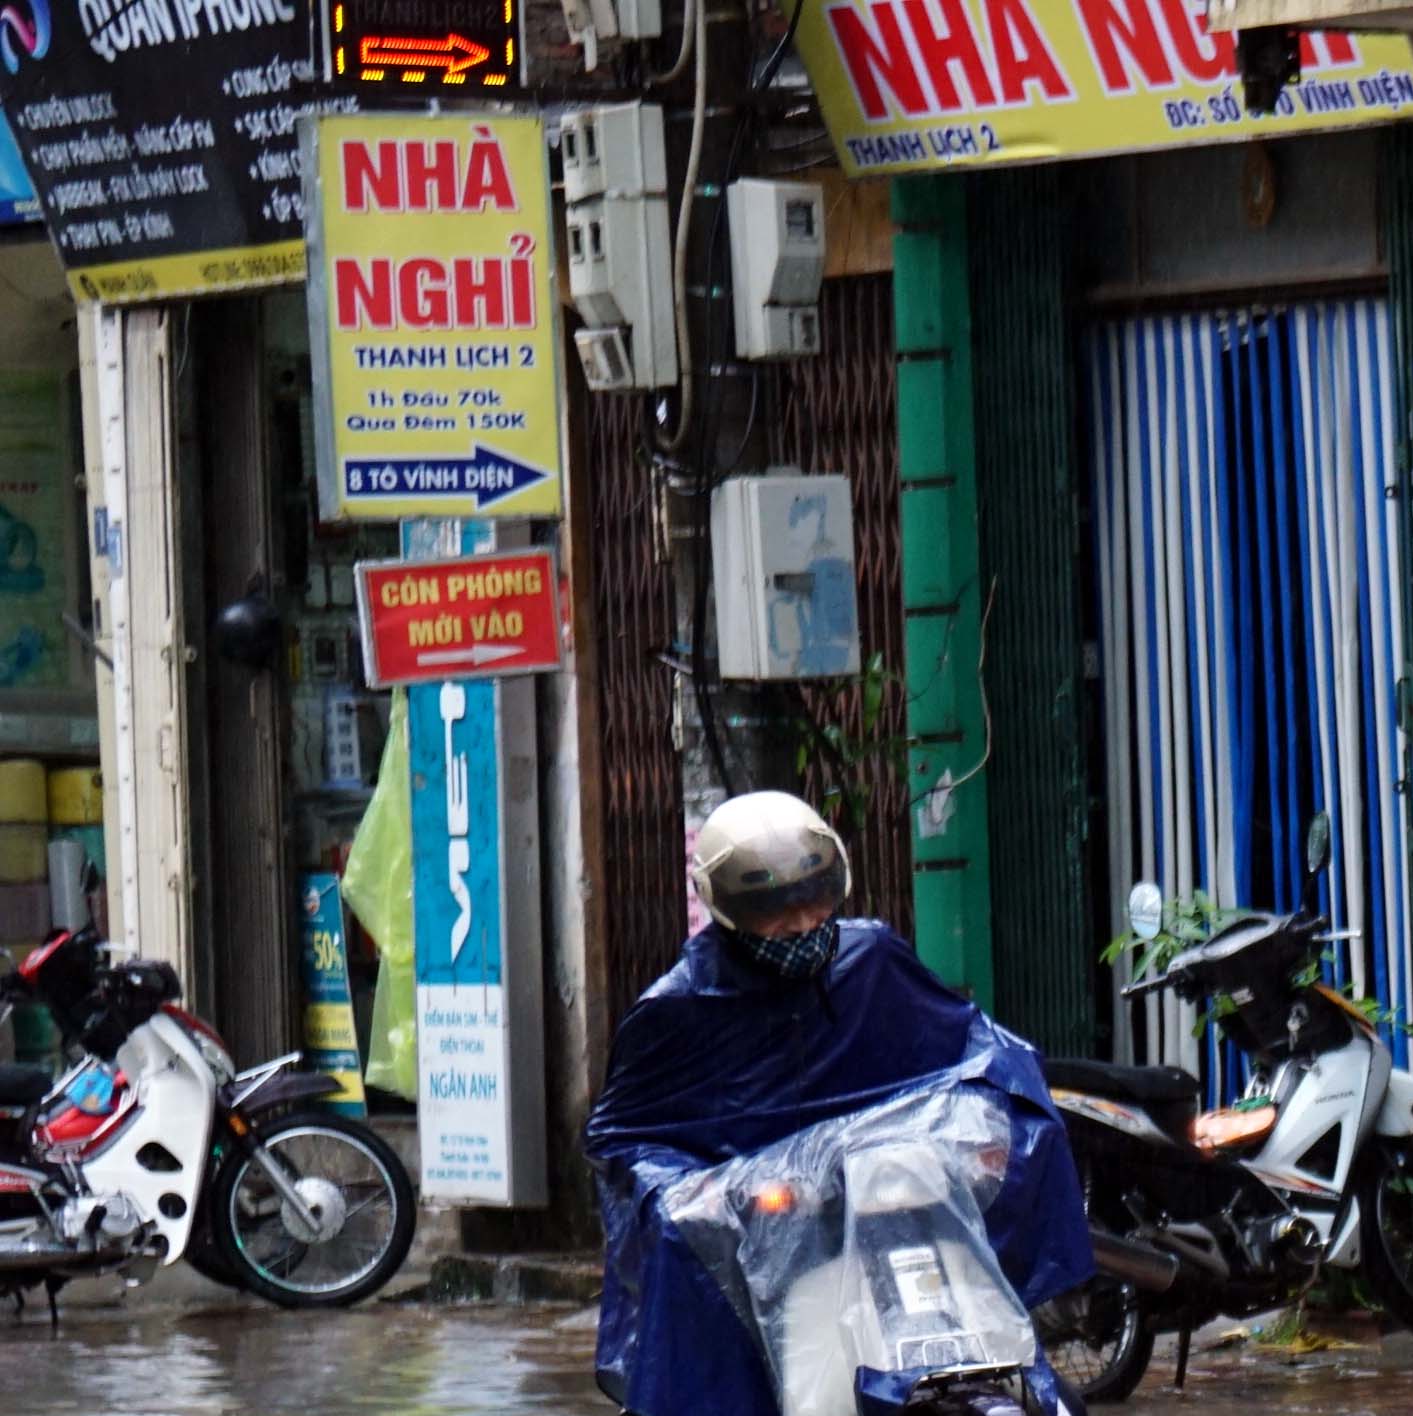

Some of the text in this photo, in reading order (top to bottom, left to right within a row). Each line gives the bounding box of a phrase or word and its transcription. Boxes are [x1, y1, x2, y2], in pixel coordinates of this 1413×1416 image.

[847, 133, 927, 166] THANH
[981, 124, 999, 151] 2
[341, 125, 516, 211] NHÀ
[335, 233, 535, 327] NGHỈ
[355, 345, 535, 371] THANH LỊCH 2
[368, 391, 394, 408] 1h
[458, 390, 502, 407] 70k
[346, 416, 396, 432] Qua
[467, 413, 527, 430] 150K
[349, 468, 362, 492] 8
[465, 462, 514, 492] DIỆN
[380, 565, 542, 608] CÒN PHÒNG
[470, 606, 523, 641] VÀO
[470, 1071, 497, 1099] ANH
